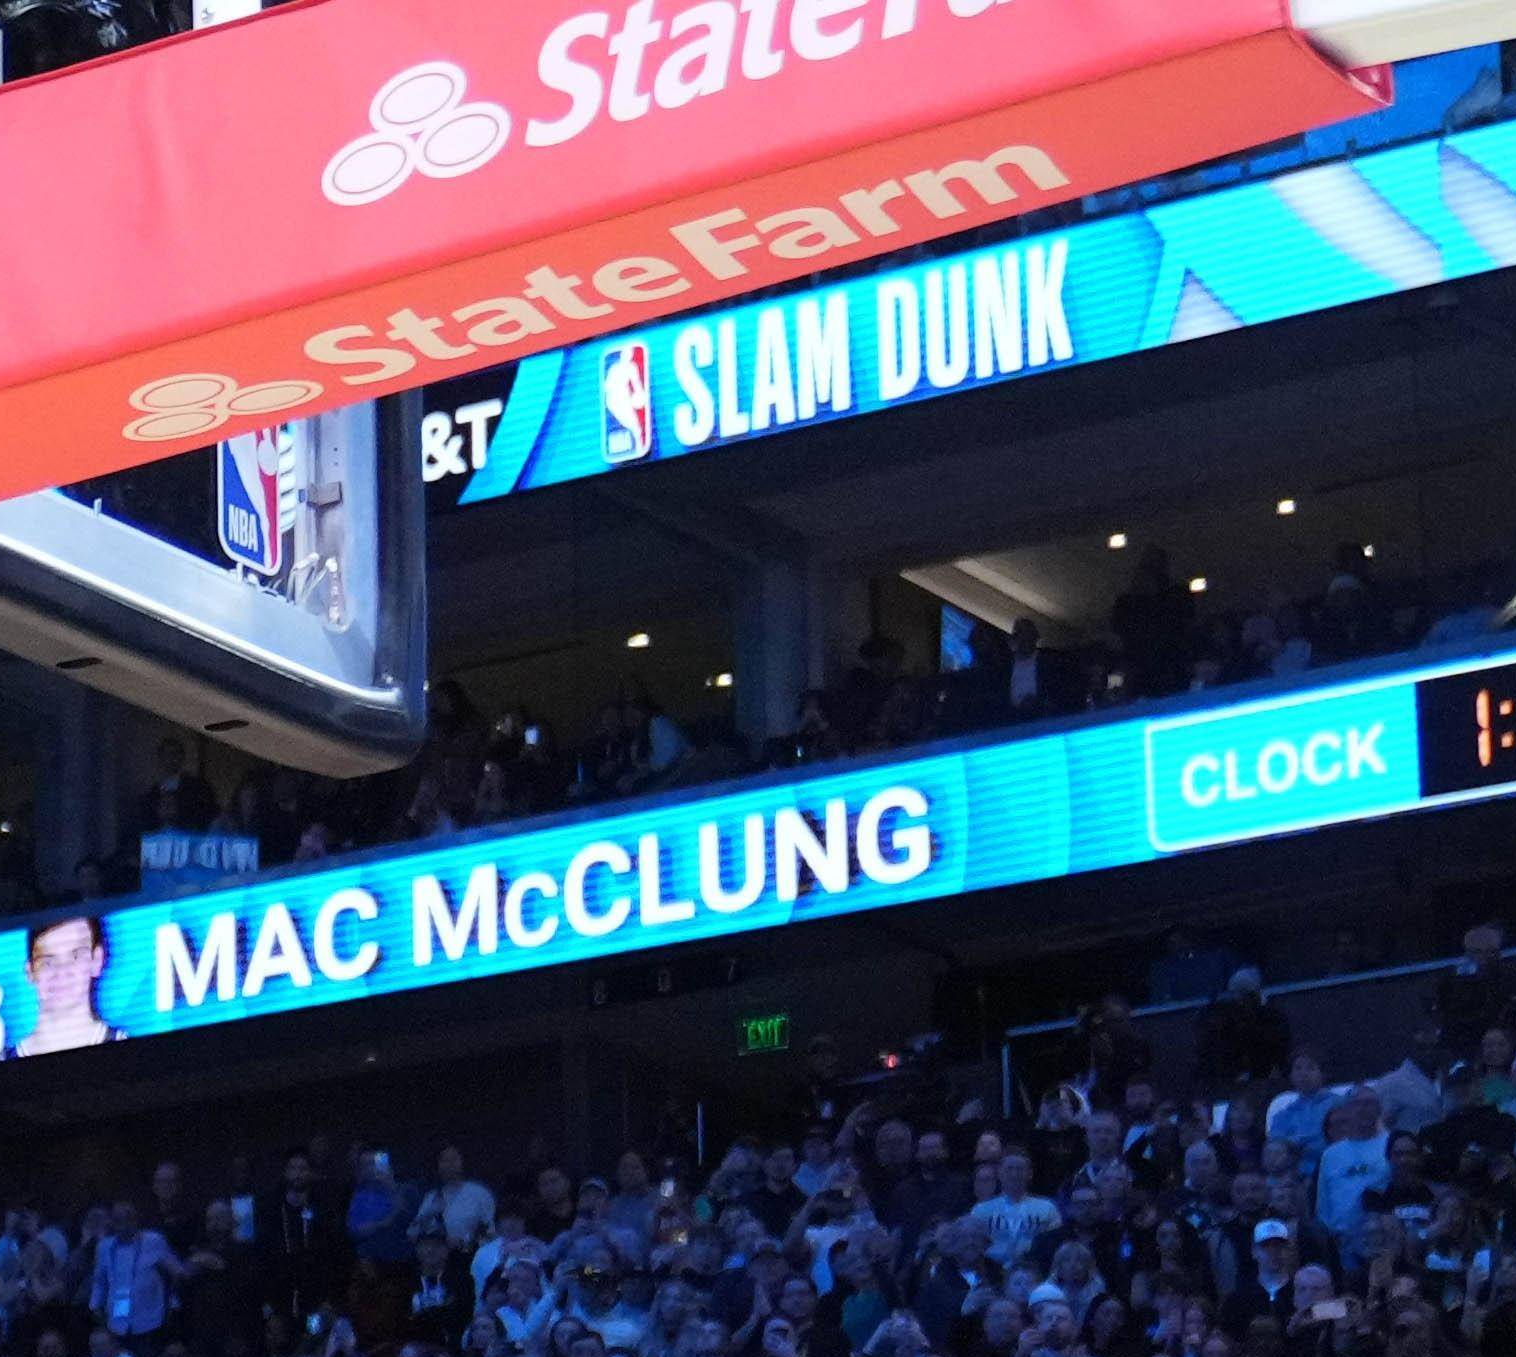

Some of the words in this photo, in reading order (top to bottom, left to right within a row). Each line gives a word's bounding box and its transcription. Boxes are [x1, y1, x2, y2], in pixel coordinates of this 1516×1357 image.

[673, 296, 852, 447] SLAM
[877, 240, 1075, 399] DUNK
[228, 504, 260, 553] NBA
[1180, 723, 1388, 809] CLOCK
[154, 888, 382, 1014] MAC
[411, 786, 934, 967] McCLUNG
